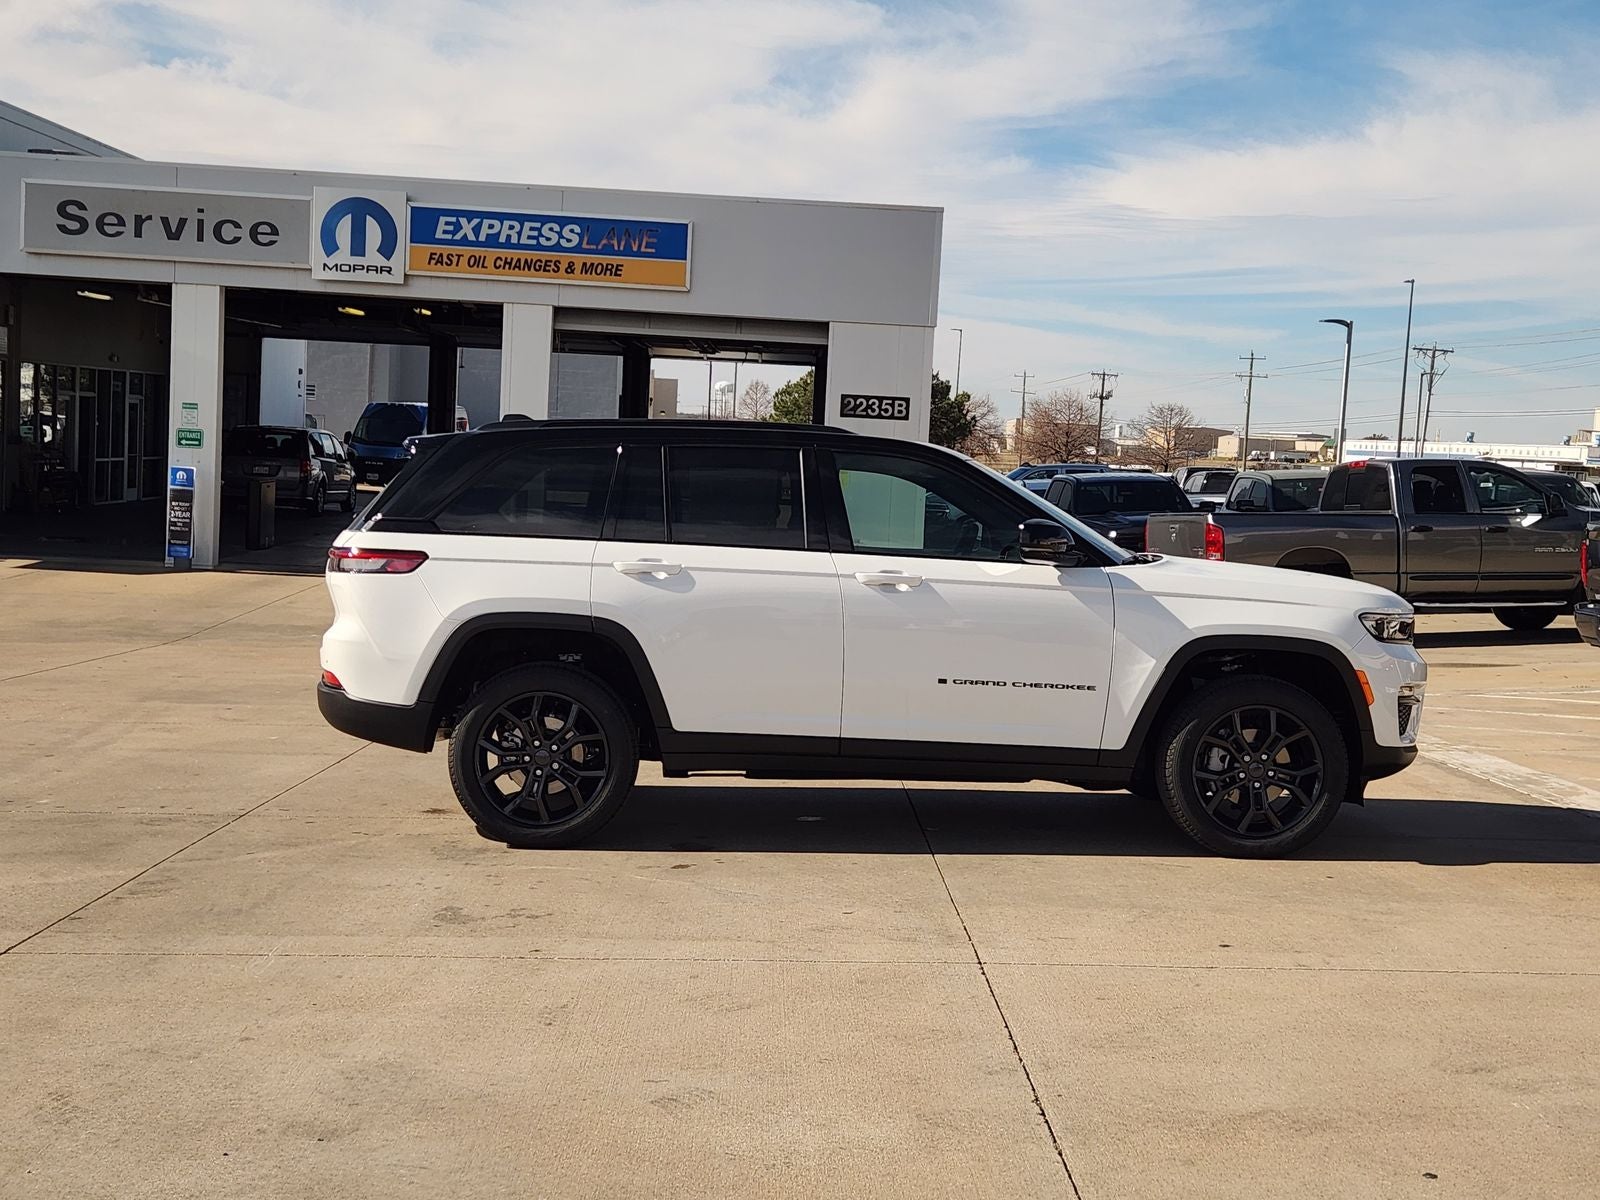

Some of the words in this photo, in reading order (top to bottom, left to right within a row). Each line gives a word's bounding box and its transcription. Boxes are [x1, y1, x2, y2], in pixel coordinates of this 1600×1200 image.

[55, 199, 280, 247] Service
[322, 262, 393, 275] MOPAR
[427, 252, 464, 268] FAST
[467, 254, 489, 269] OIL
[493, 256, 561, 274] CHANGES
[565, 261, 576, 275] &
[580, 262, 625, 278] MORE
[843, 397, 907, 417] 2235B
[178, 431, 201, 439] ENTRANCE
[952, 678, 1007, 687] GRAND
[1012, 681, 1097, 692] CHEROKEE
